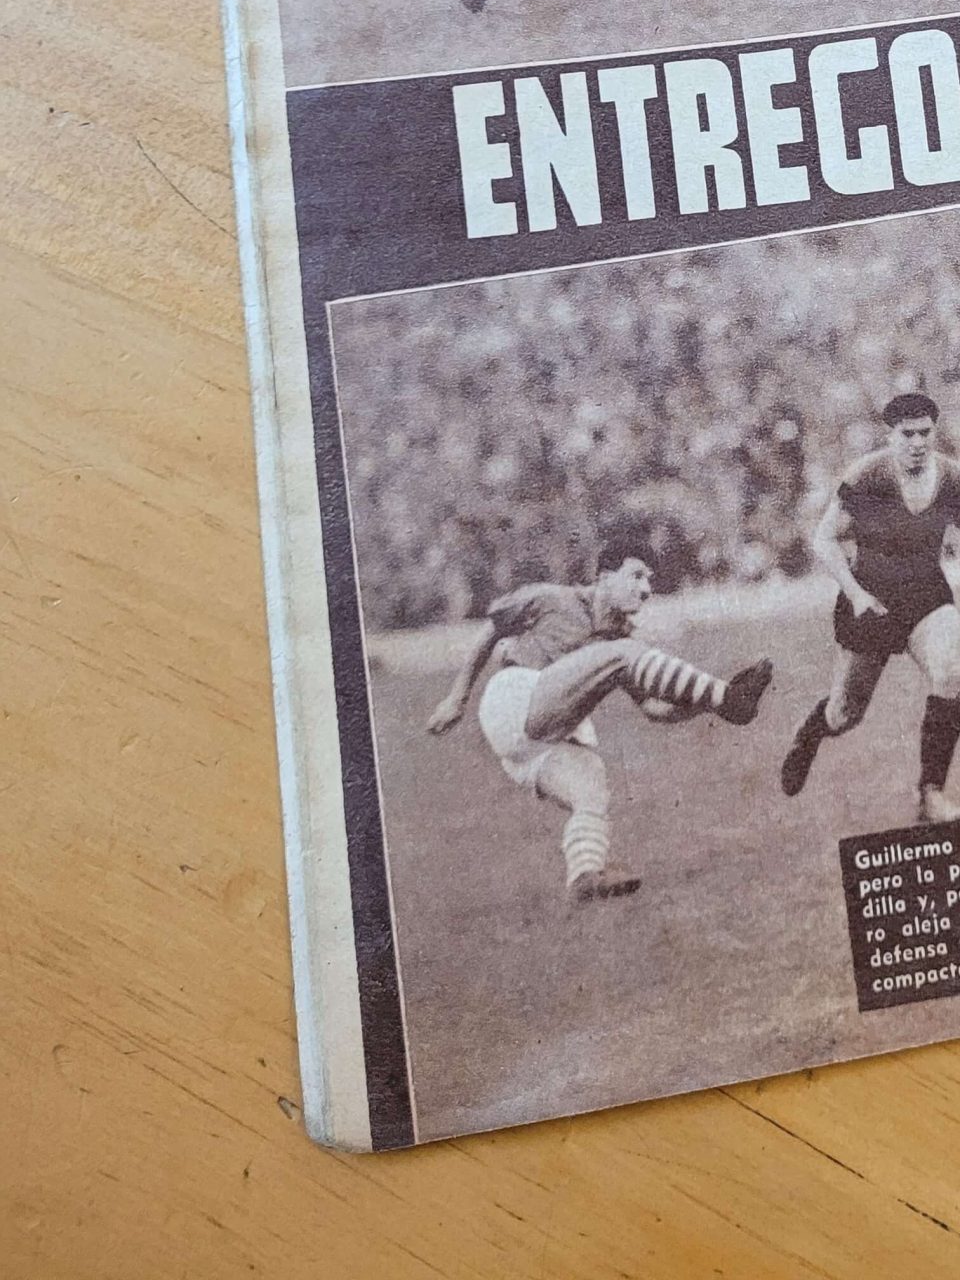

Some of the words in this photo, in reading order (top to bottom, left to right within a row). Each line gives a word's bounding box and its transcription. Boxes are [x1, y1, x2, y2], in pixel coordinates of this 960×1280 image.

[855, 840, 953, 869] Guillermo
[860, 873, 903, 898] pero
[916, 866, 934, 884] la
[863, 895, 906, 918] dilla
[917, 894, 935, 912] y,
[866, 927, 886, 942] ro
[902, 912, 951, 937] aleja
[870, 941, 948, 968] defensa
